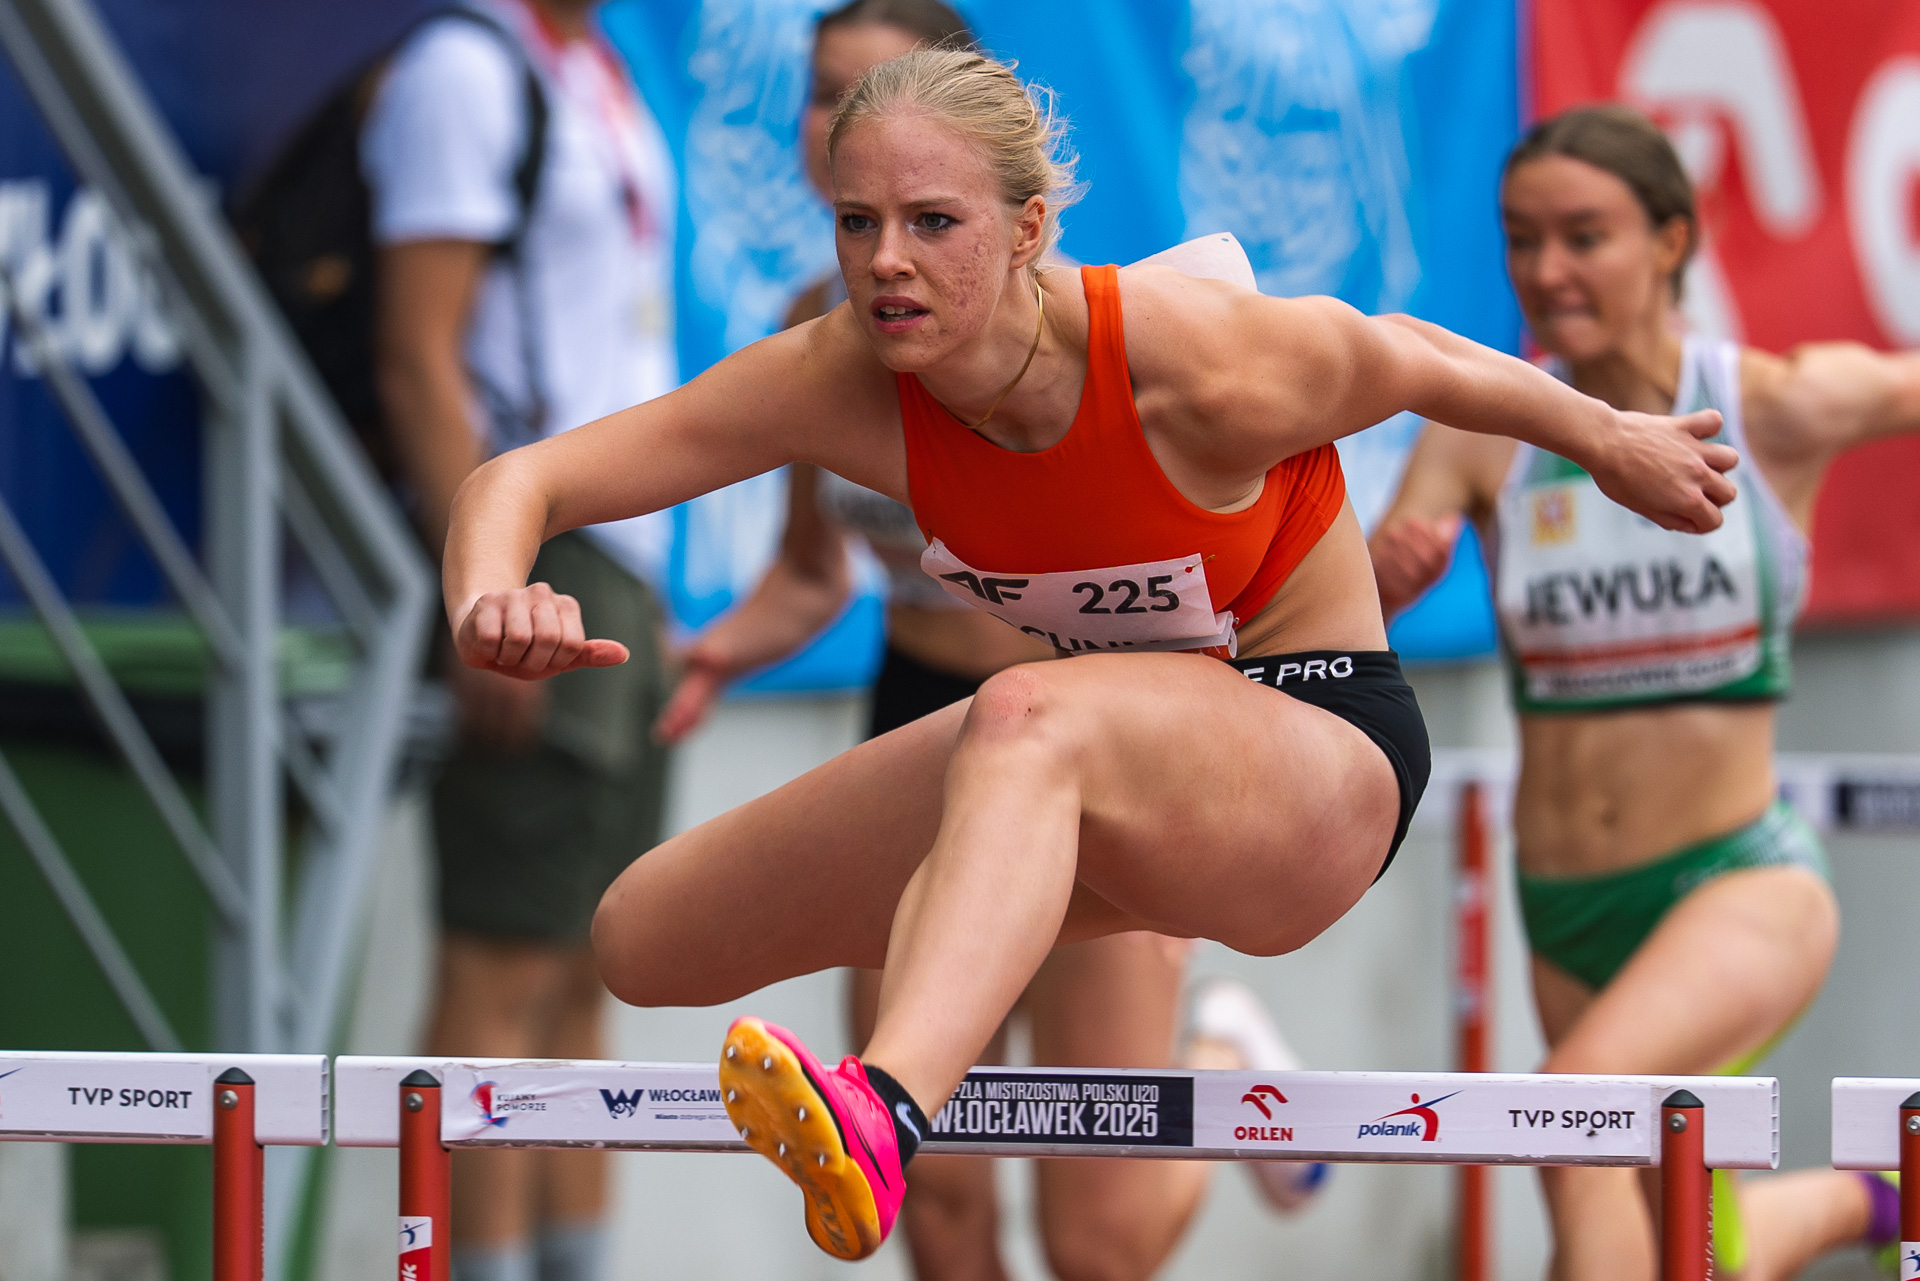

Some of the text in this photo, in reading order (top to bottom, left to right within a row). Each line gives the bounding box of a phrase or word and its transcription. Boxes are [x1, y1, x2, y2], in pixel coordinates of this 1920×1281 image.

[1072, 574, 1180, 614] 225
[1276, 656, 1353, 686] PRO
[68, 1087, 192, 1109] TVP SPORT
[648, 1089, 724, 1102] WŁOCŁAW
[985, 1082, 1080, 1101] MISTRZOSTWA
[1082, 1083, 1130, 1102] POLSKI
[1132, 1084, 1159, 1103] U20
[497, 1102, 547, 1111] POMORZE
[931, 1100, 1158, 1137] WŁOCŁAWEK 2025
[1508, 1110, 1636, 1129] TVP SPORT
[1234, 1126, 1293, 1142] ORLEN
[1357, 1121, 1421, 1139] polanik
